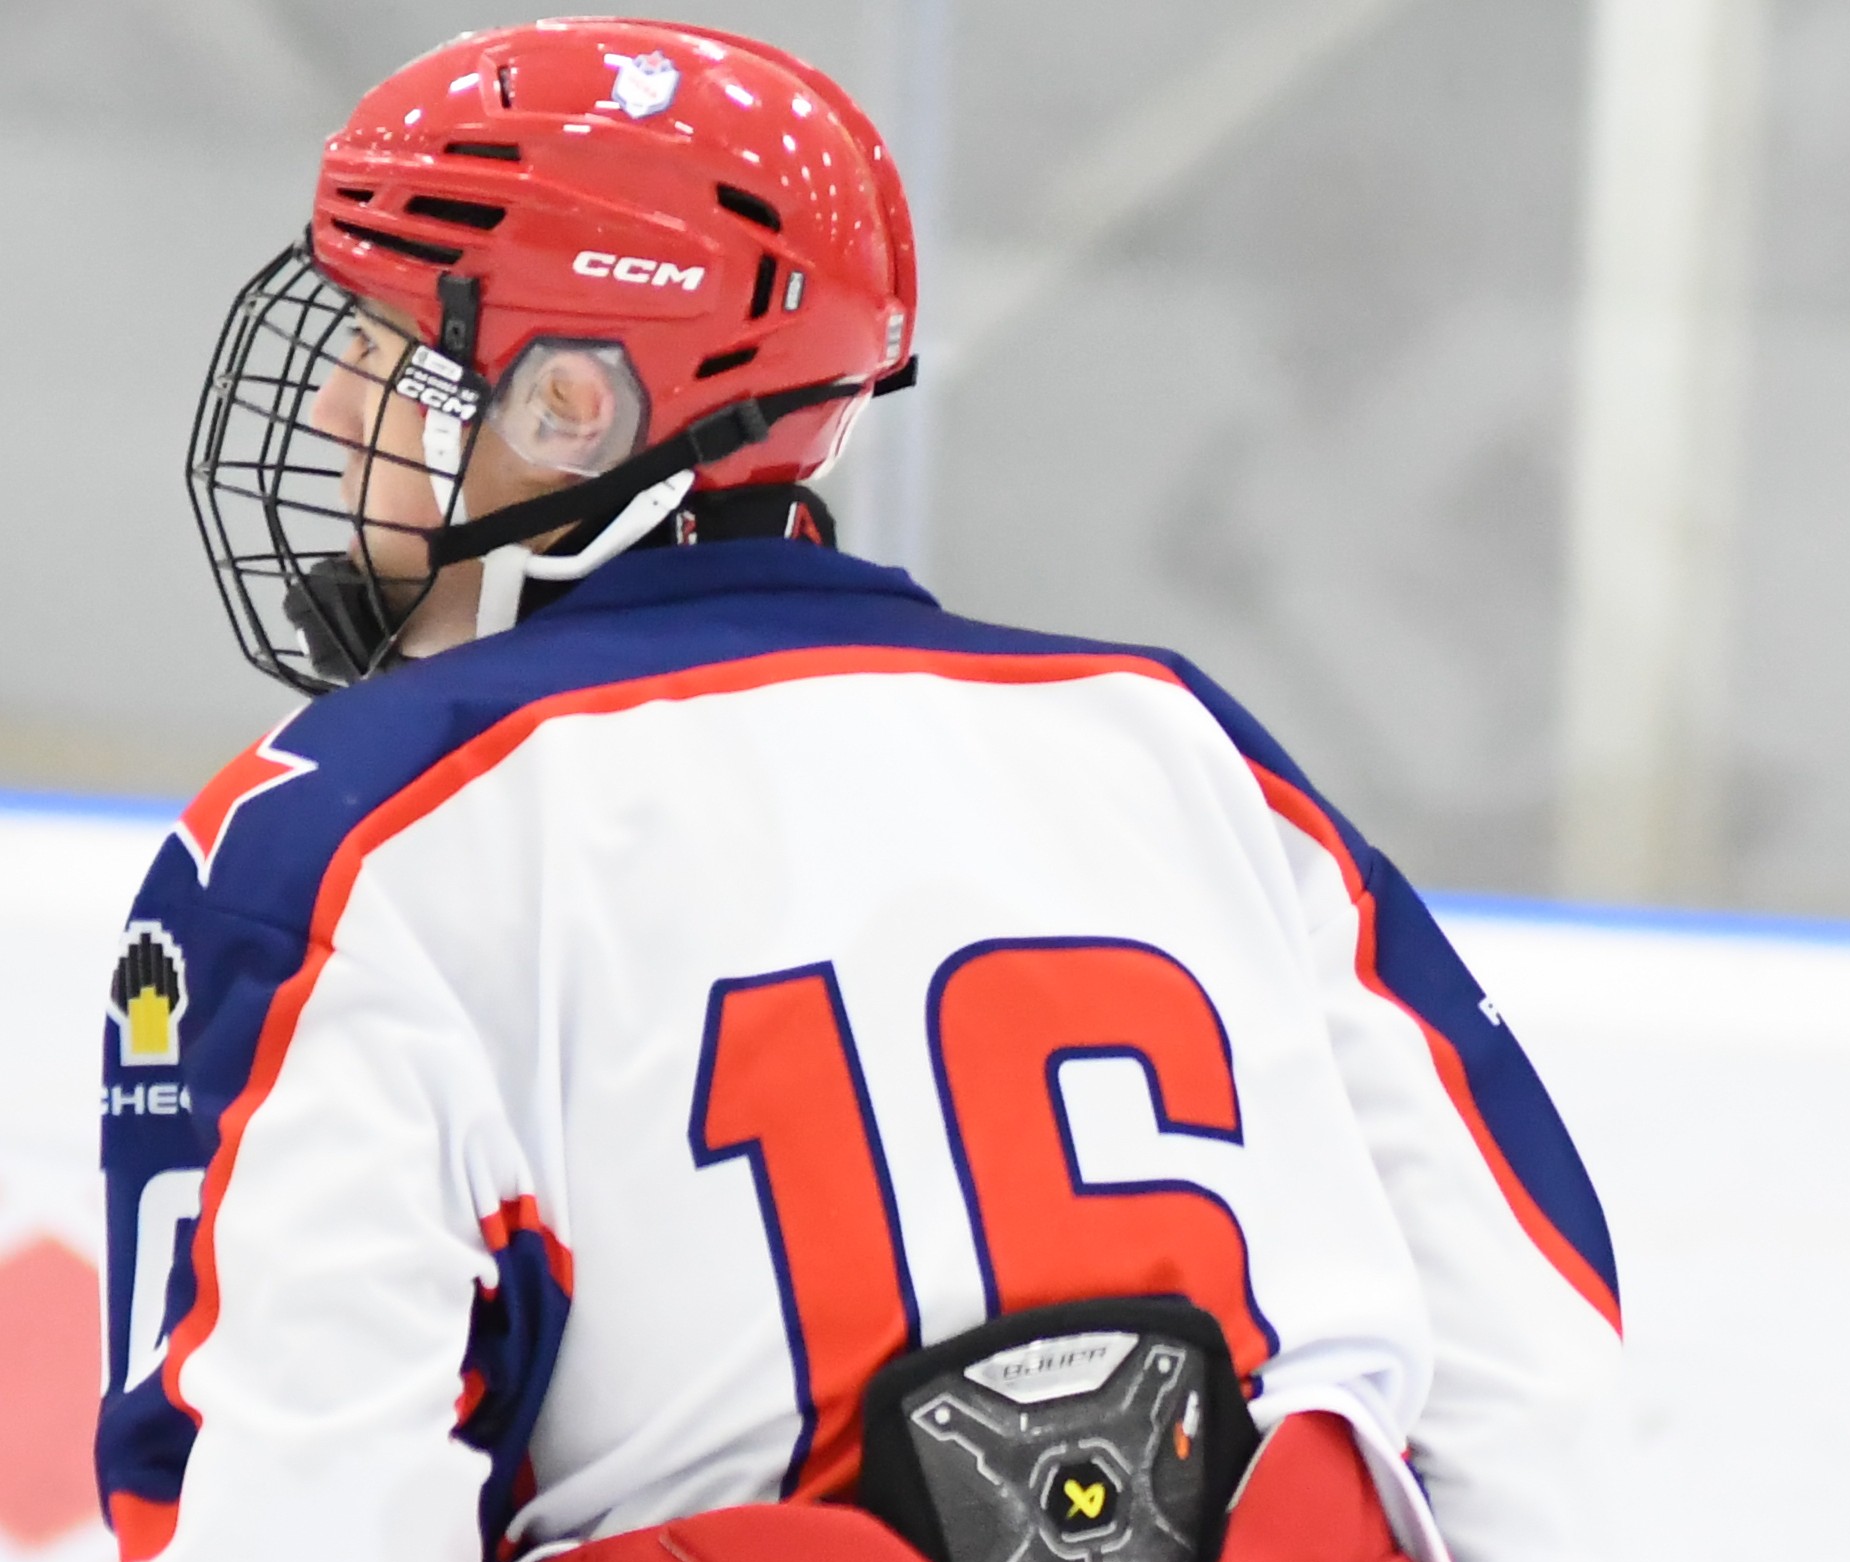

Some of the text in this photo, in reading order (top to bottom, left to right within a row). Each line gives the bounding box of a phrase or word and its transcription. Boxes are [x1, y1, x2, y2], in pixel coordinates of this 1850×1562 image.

[573, 250, 705, 292] CCM
[396, 377, 477, 421] CCM
[687, 935, 1281, 1502] 16
